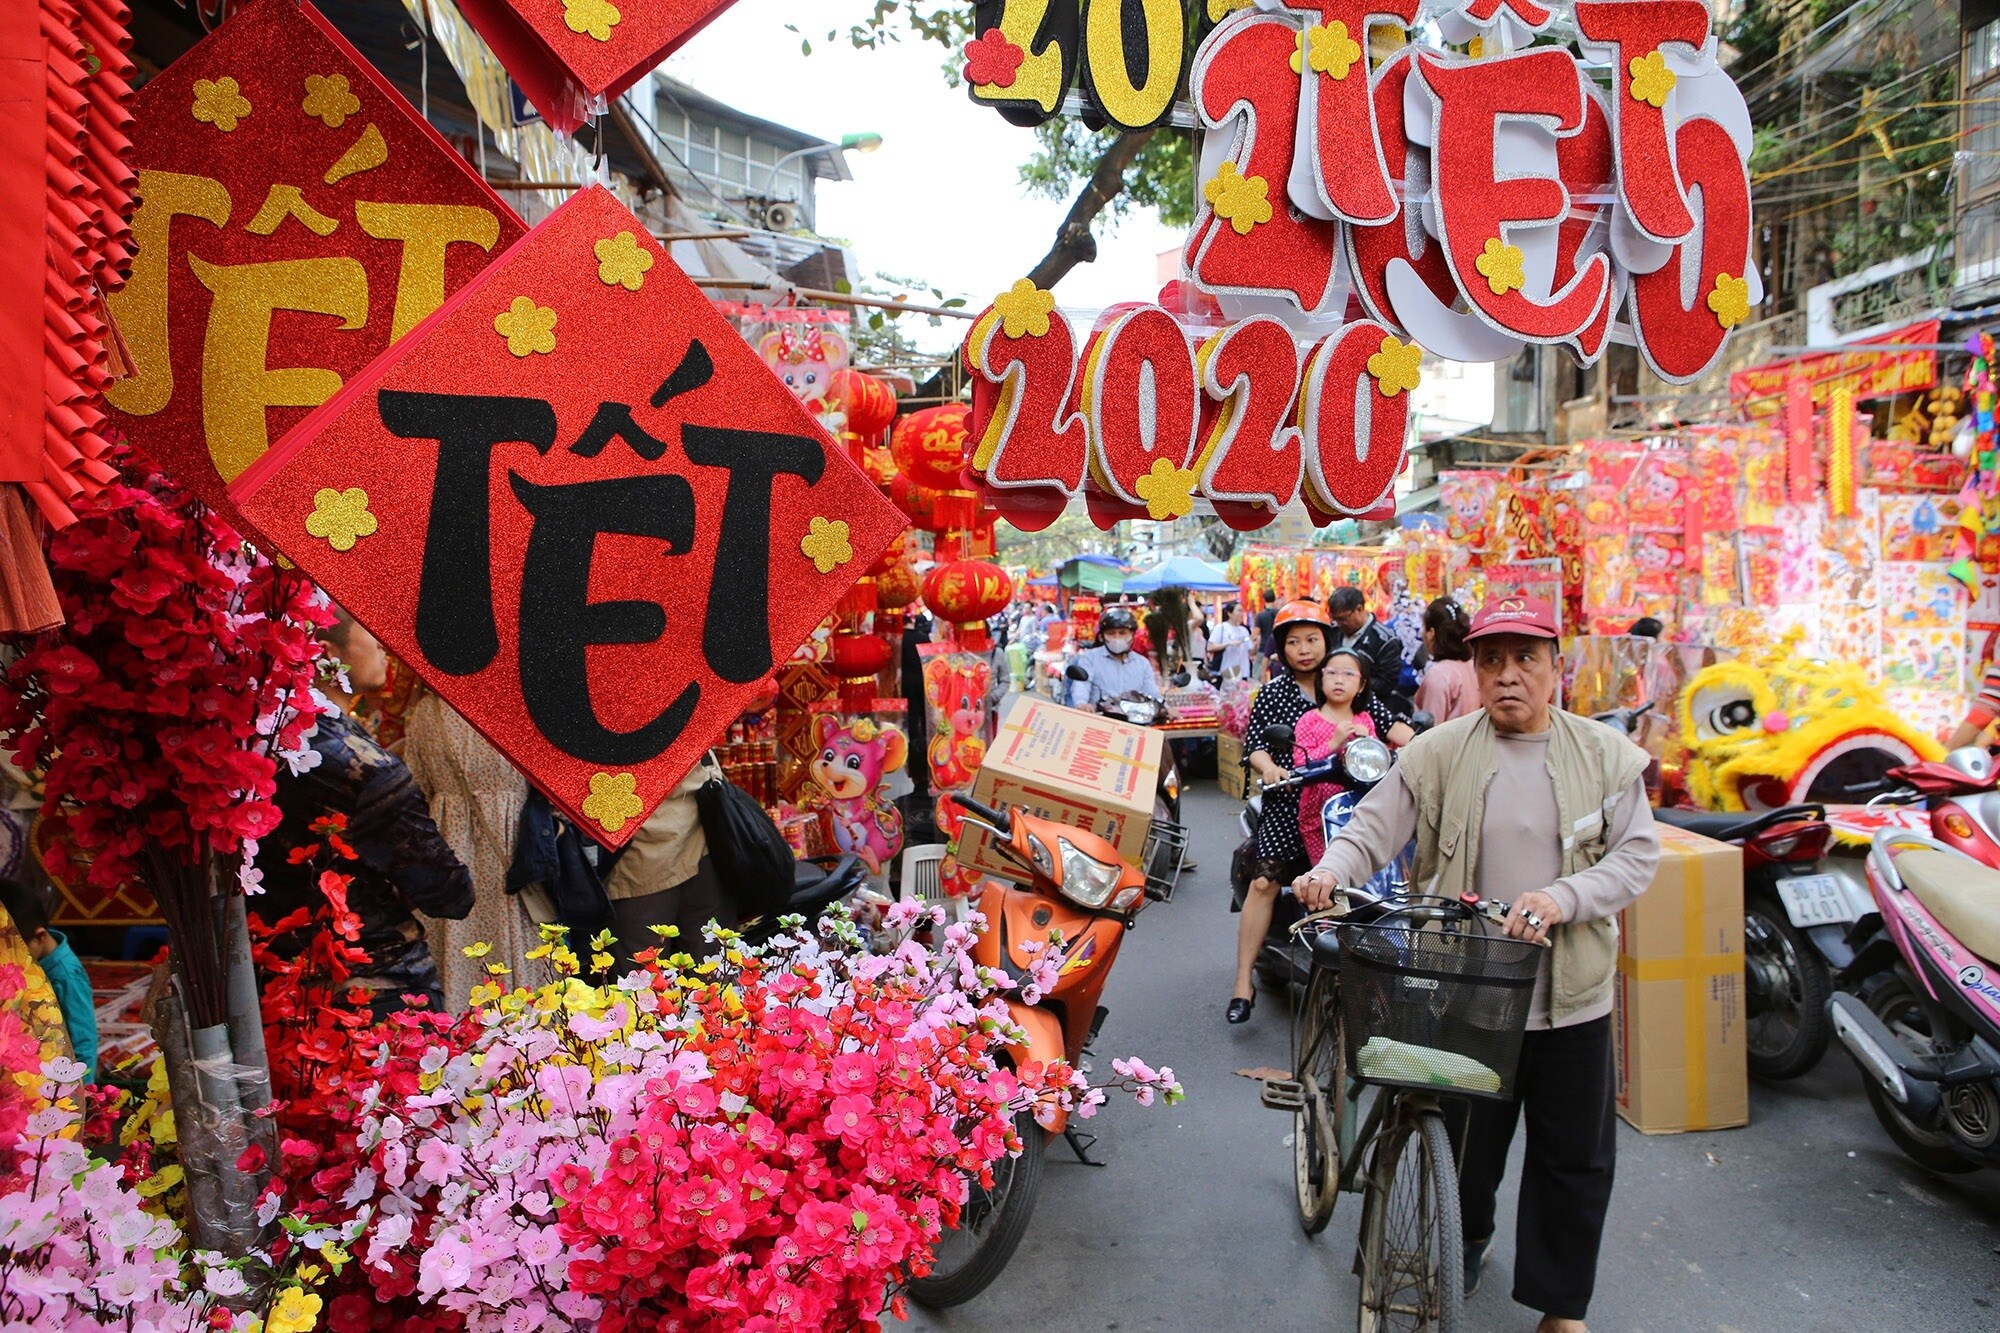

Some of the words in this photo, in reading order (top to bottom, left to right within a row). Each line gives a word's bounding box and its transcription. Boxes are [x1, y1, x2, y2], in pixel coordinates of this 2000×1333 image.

[980, 303, 1411, 515] 2020
[379, 338, 826, 765] TẾT
[1080, 727, 1113, 751] HOA
[1799, 901, 1845, 921] 4401
